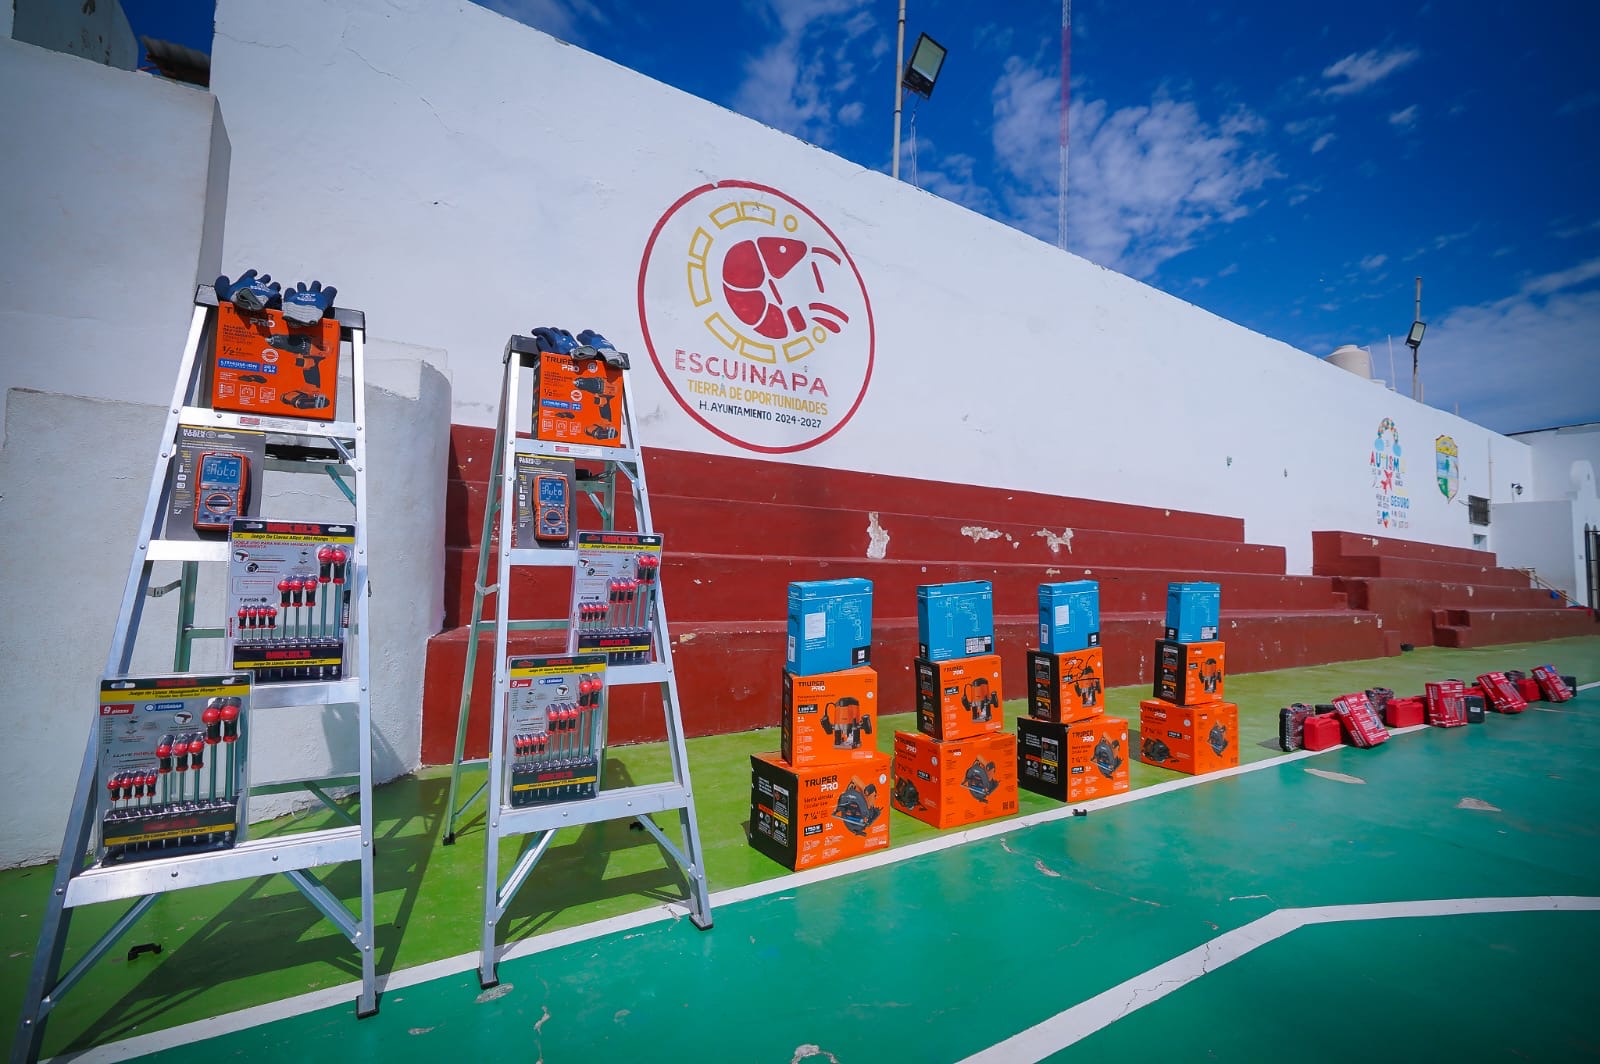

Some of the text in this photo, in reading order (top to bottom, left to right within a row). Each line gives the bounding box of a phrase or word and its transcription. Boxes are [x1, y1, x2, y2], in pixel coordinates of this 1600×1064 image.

[249, 317, 276, 328] PRO
[544, 356, 577, 366] TRUPE
[561, 364, 580, 372] PRO
[675, 349, 829, 397] ESCUINAPA
[687, 379, 828, 416] TIERRA DE OPORTUNIDADES
[711, 402, 772, 421] AYUNTAMIENTO
[775, 413, 821, 429] 2024-2027
[211, 463, 236, 477] Auto
[544, 485, 562, 497] Auto
[104, 706, 111, 714] 9
[805, 775, 838, 787] TRUPER
[821, 782, 839, 792] PRO
